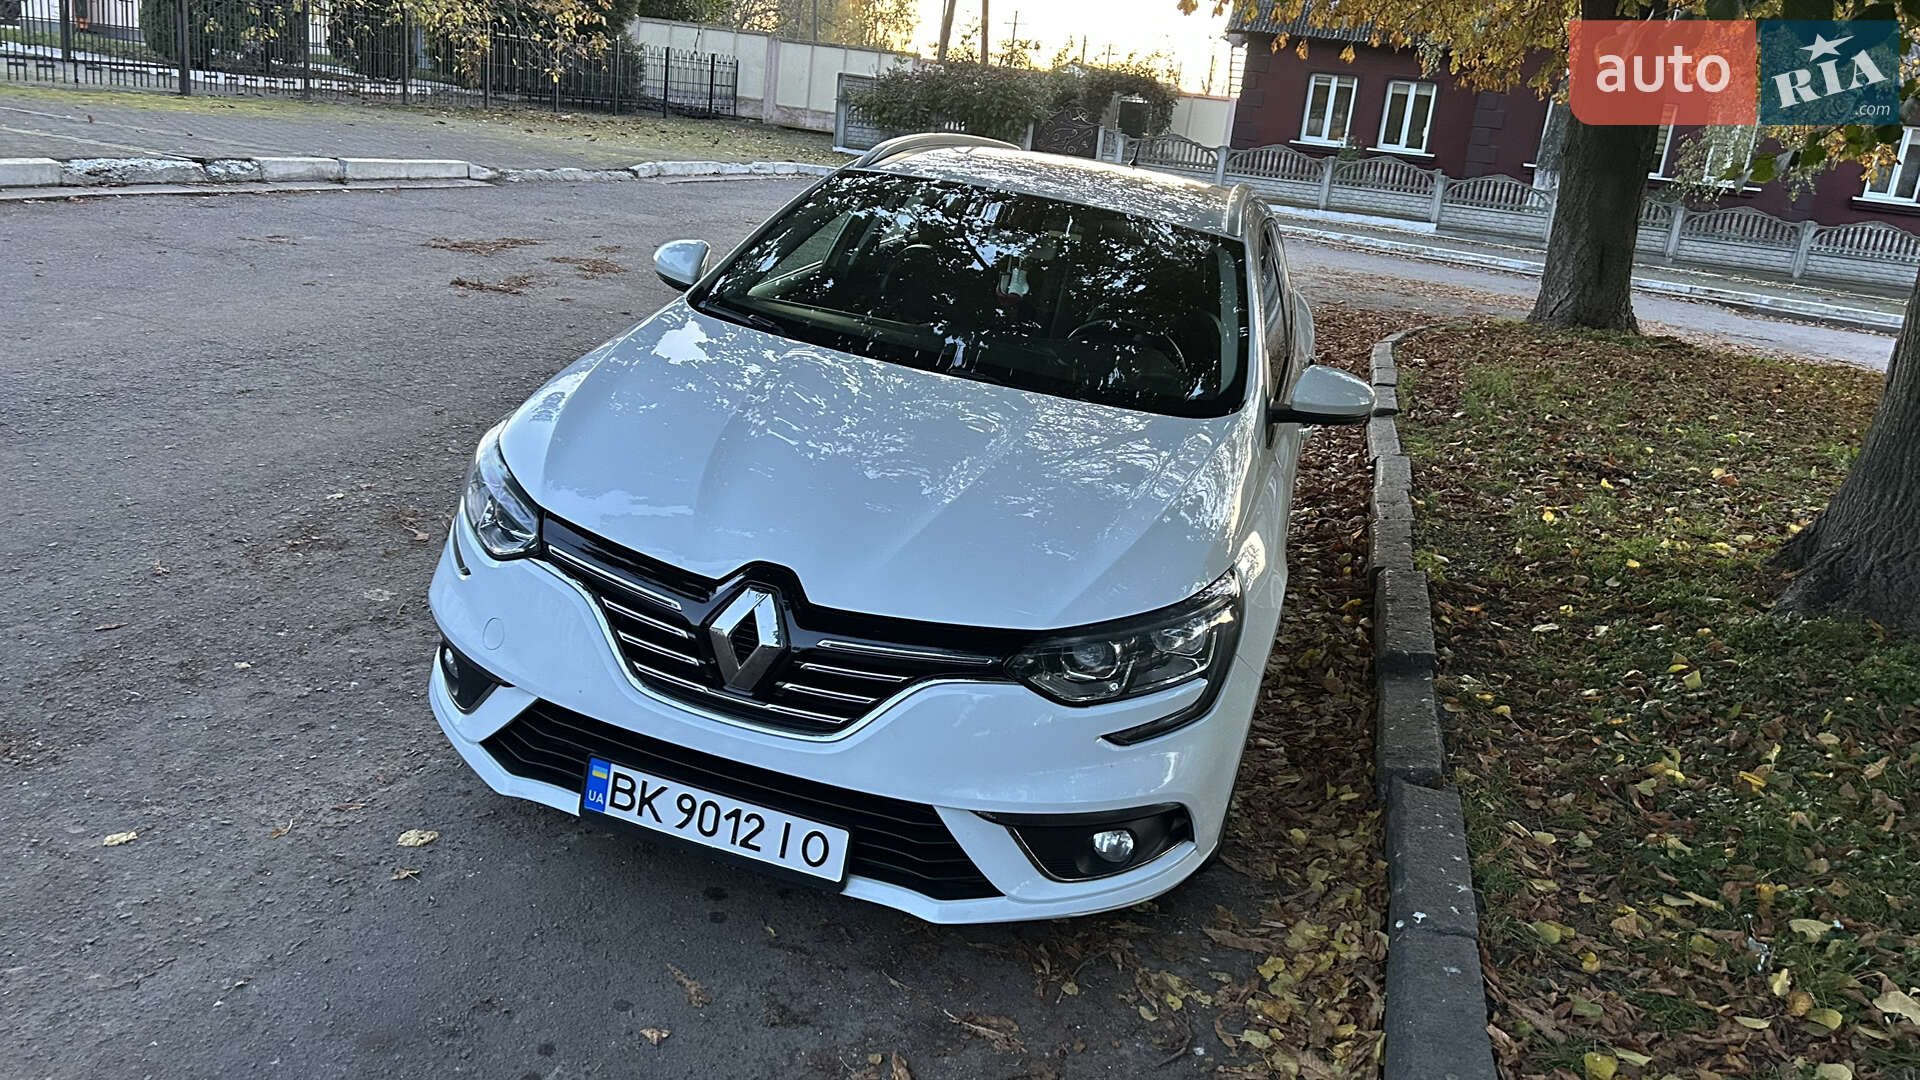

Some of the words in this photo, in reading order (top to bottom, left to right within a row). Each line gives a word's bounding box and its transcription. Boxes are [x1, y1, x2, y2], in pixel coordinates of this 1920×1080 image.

[588, 789, 604, 804] UA
[608, 771, 669, 824] BK
[674, 793, 765, 852] 9012
[778, 821, 830, 868] IO
